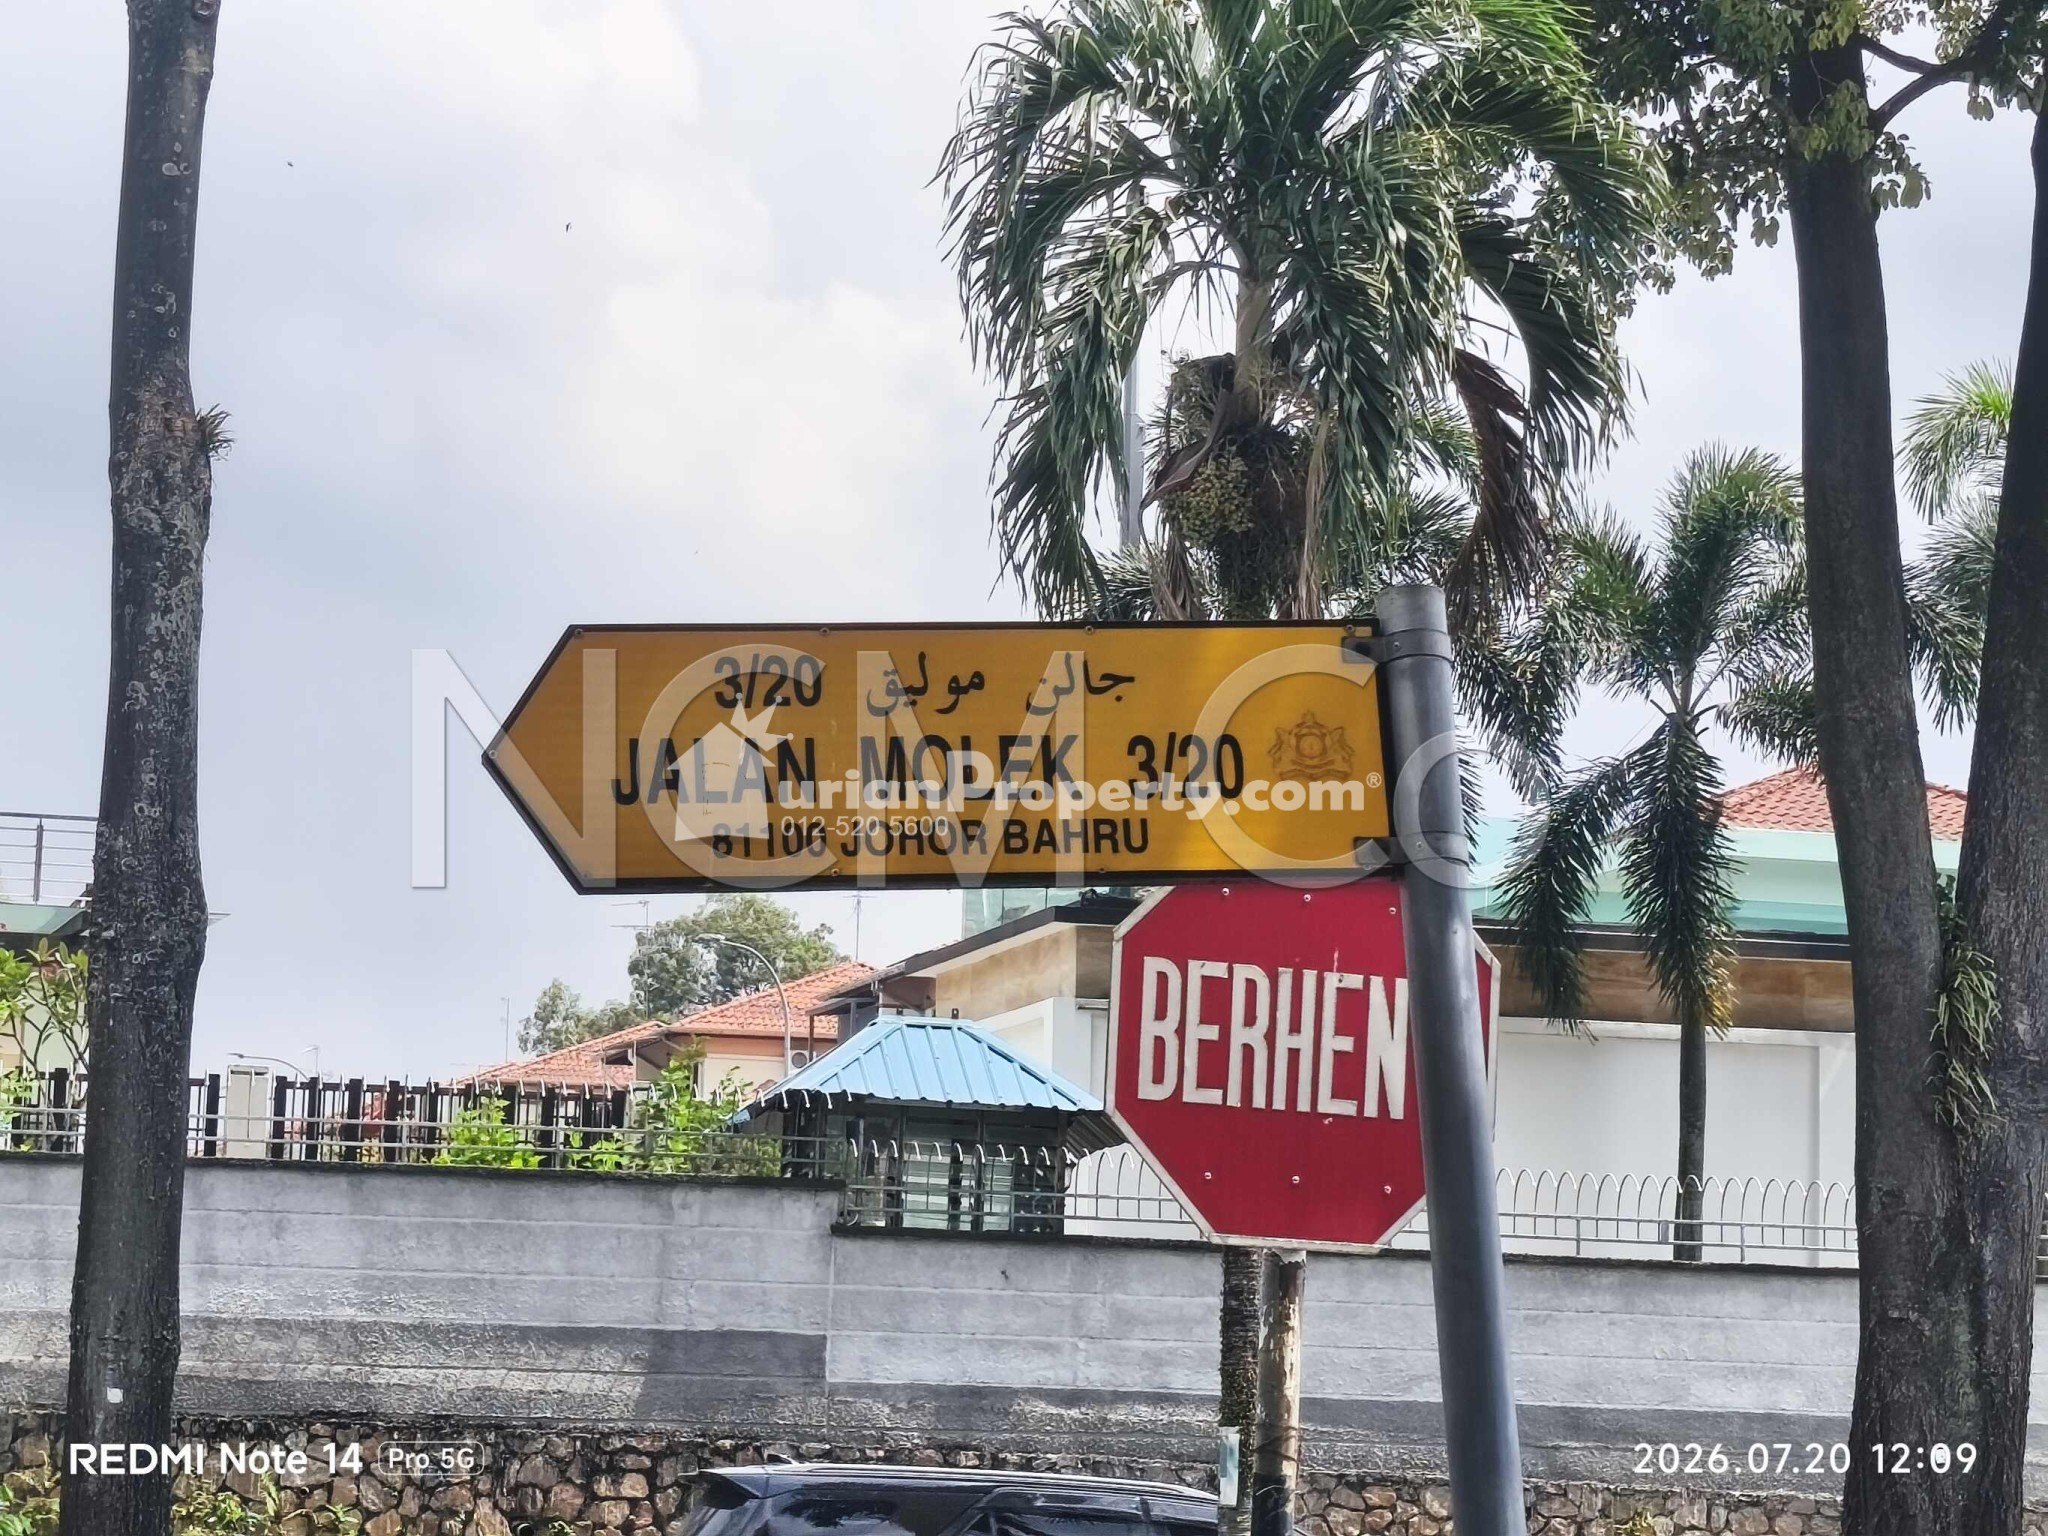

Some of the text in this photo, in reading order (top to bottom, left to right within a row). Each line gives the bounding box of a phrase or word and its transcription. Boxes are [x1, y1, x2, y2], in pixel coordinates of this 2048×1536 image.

[714, 653, 822, 709] 3/20
[1026, 651, 1135, 716] جالن
[611, 732, 1245, 805] JALAN MOLEK 3/20
[712, 818, 1149, 859] 81100 JOHOR BAHRU
[1137, 956, 1410, 1120] BERHEN
